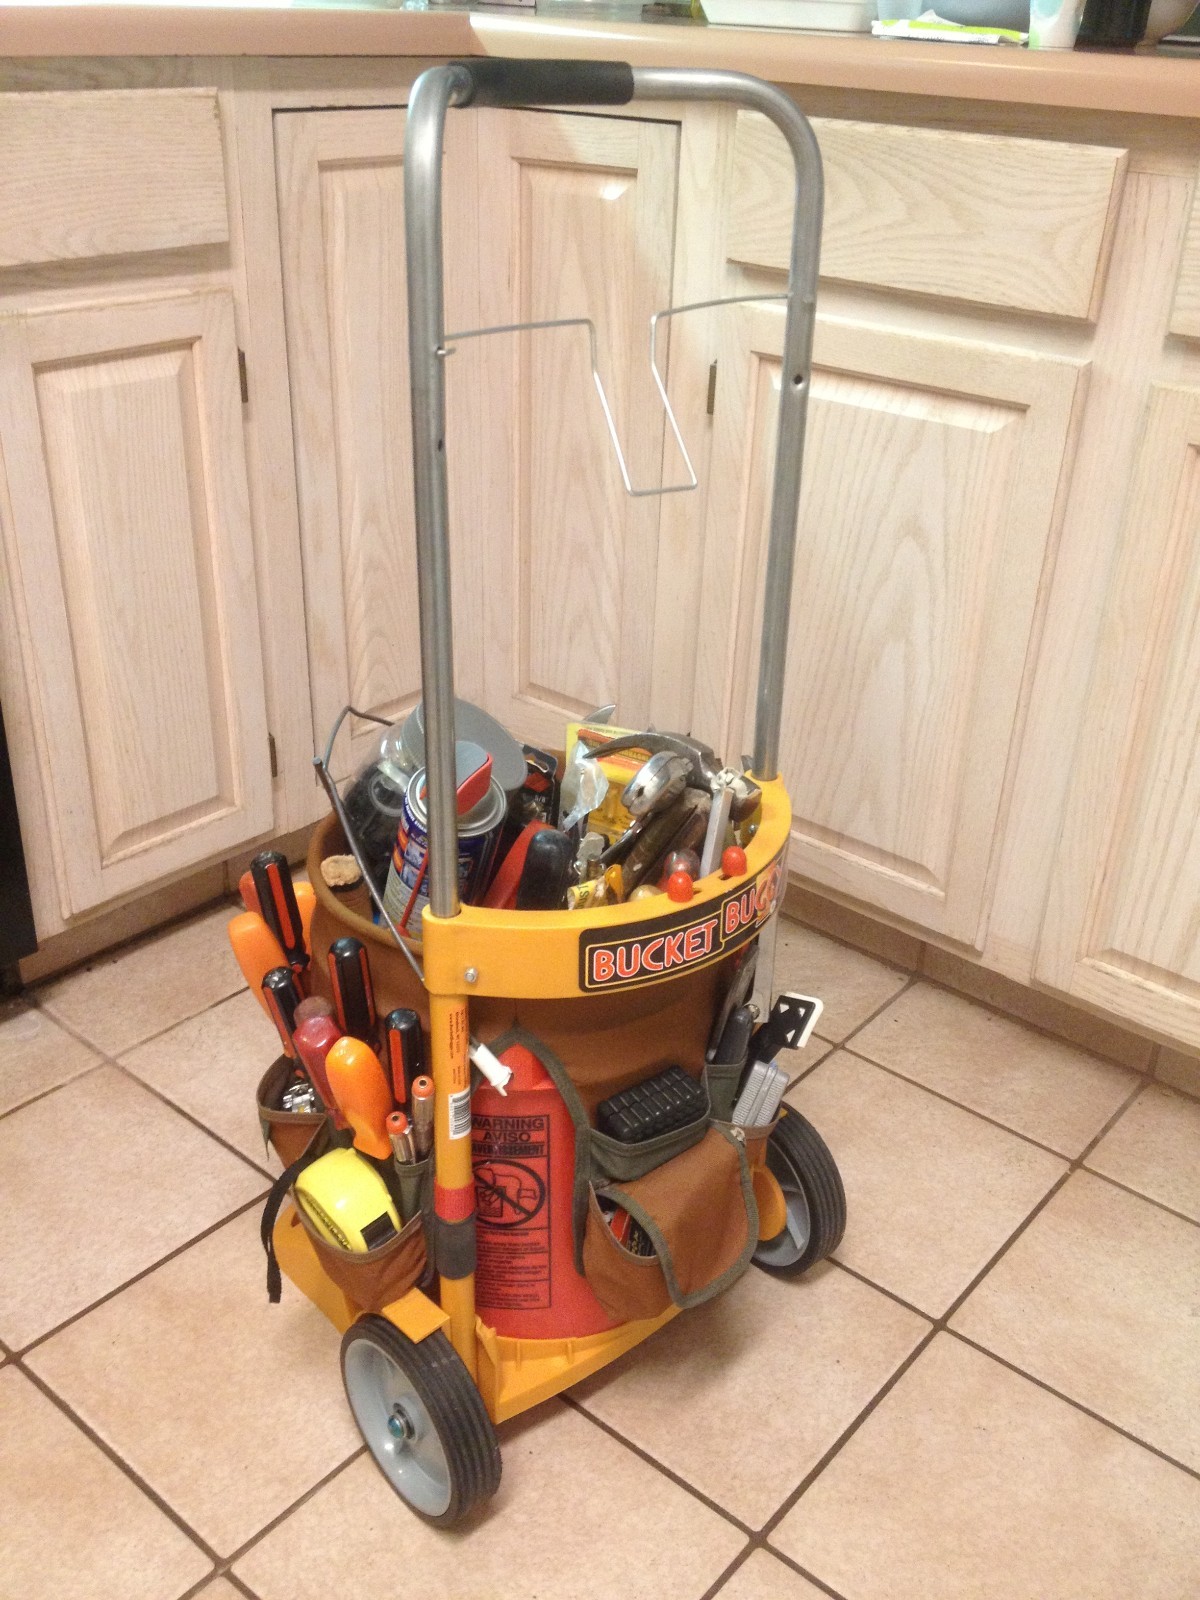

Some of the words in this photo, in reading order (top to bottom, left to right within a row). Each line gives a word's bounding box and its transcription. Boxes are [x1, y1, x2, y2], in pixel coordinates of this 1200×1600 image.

[593, 918, 718, 981] BUCKET
[471, 1116, 544, 1129] WARNING
[483, 1131, 531, 1142] AVISO
